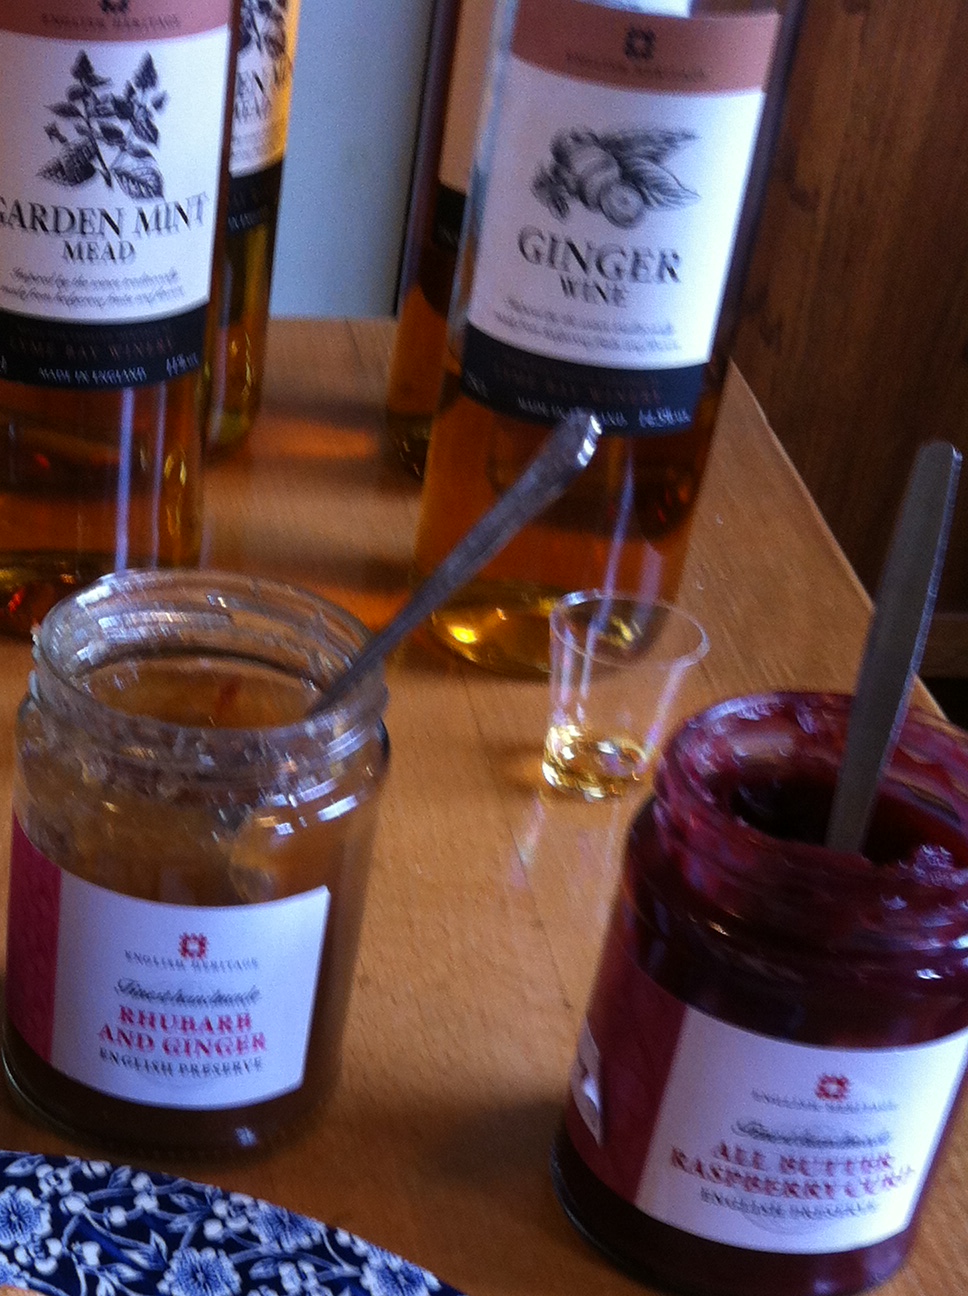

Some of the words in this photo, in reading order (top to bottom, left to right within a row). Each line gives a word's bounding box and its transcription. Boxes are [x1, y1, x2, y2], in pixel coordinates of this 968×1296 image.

[133, 192, 210, 237] MINT
[62, 240, 136, 264] MEAD
[518, 226, 681, 284] GINGER
[559, 275, 629, 308] WINE
[118, 1004, 253, 1035] RHUBARB
[98, 1023, 156, 1051] AND
[162, 1031, 268, 1059] GINGER
[98, 1047, 174, 1077] ENGLISH
[177, 1055, 263, 1079] PRESERVE
